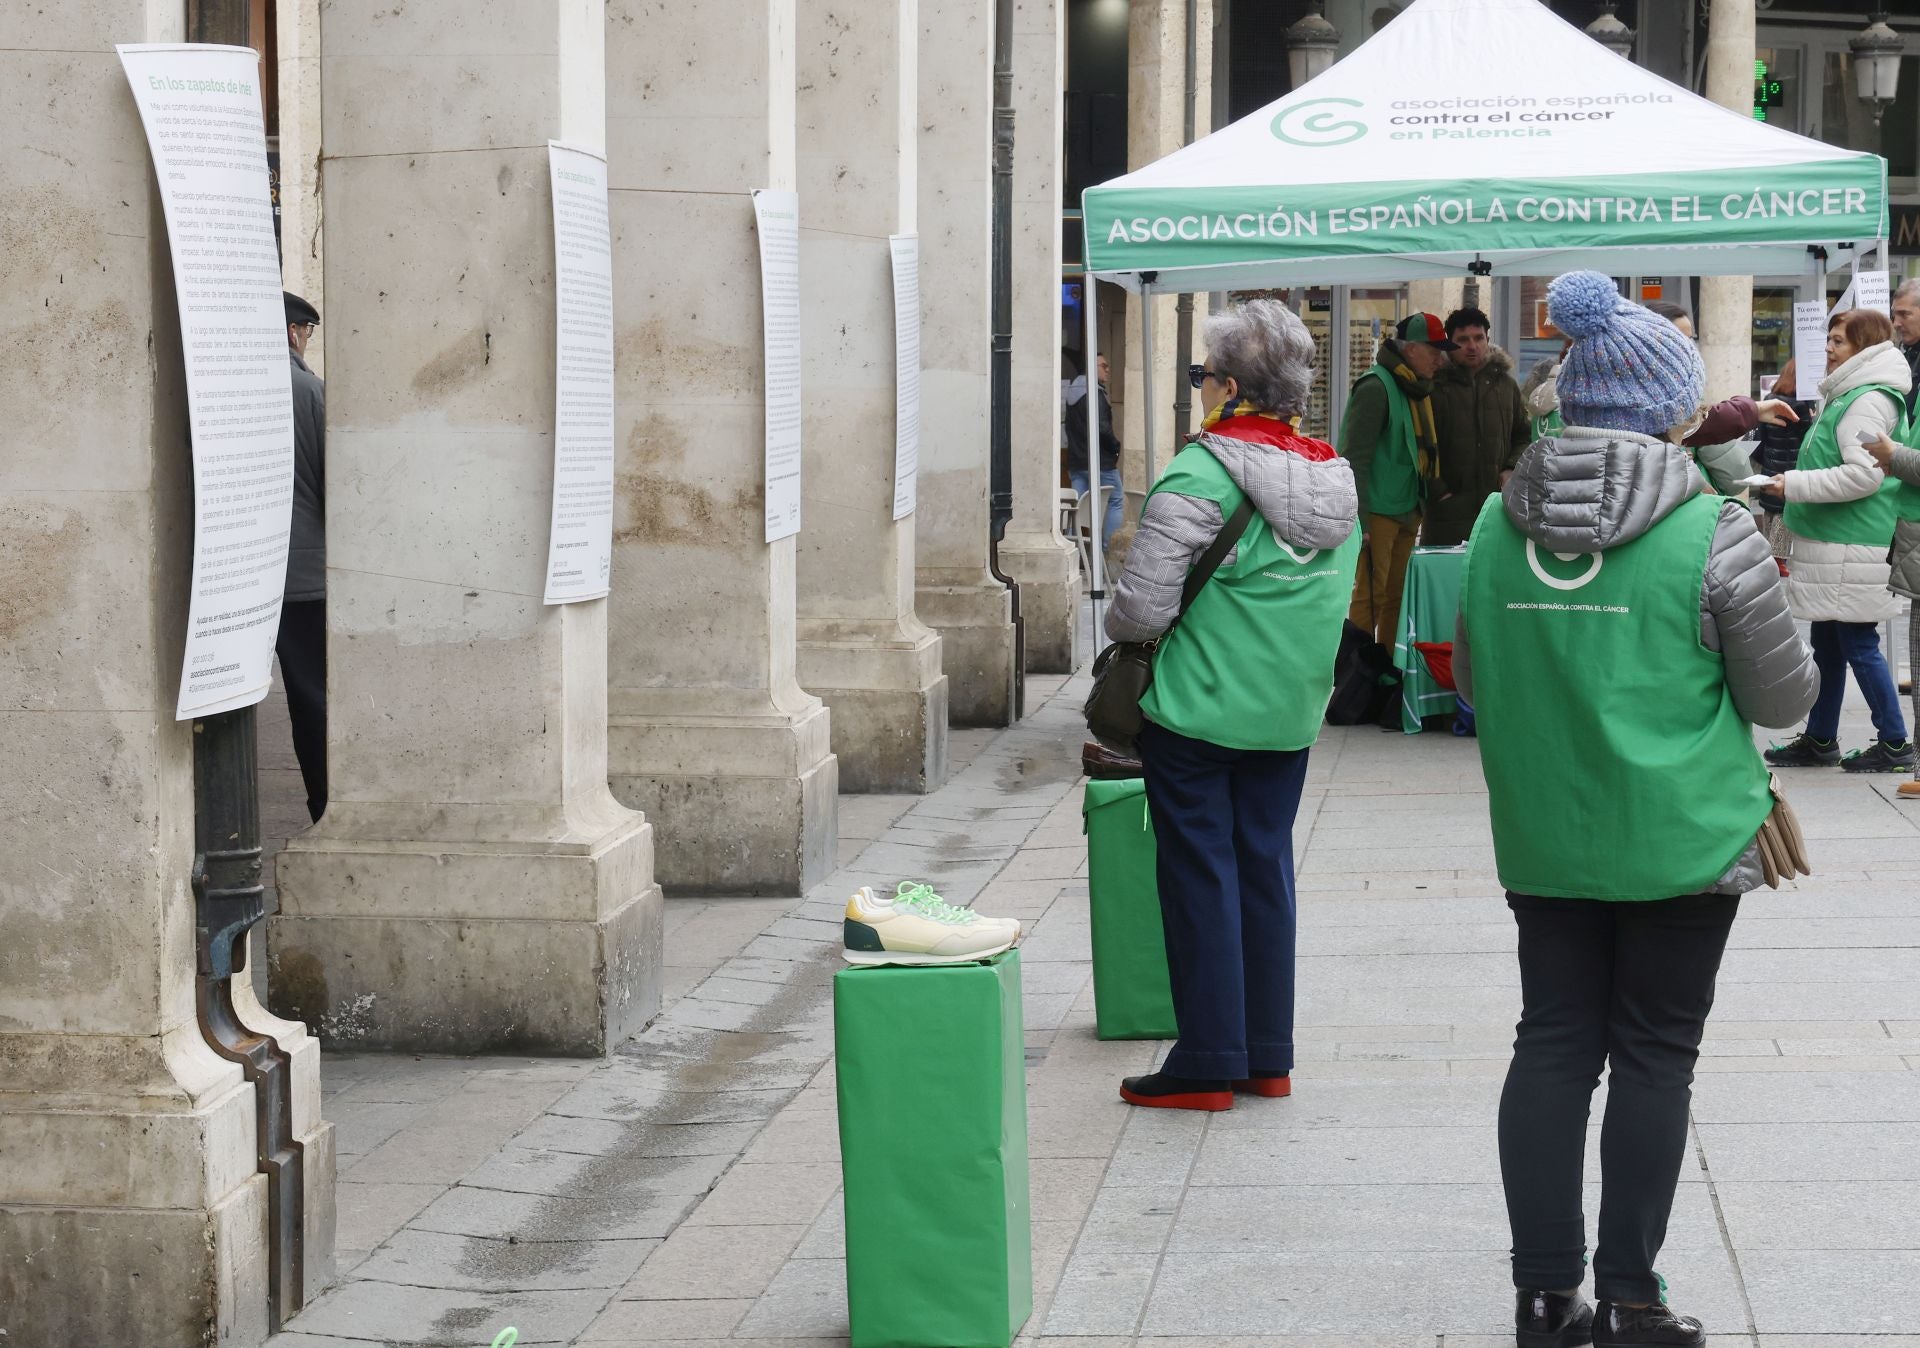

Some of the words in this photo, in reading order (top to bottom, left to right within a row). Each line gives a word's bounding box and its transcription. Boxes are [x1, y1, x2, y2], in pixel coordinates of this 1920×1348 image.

[148, 75, 166, 91] En
[166, 76, 185, 91] los
[188, 79, 226, 96] zapatos
[228, 80, 238, 94] de
[1391, 96, 1537, 110] asociación
[1546, 92, 1673, 109] española
[1390, 113, 1479, 125] contra
[1488, 112, 1510, 123] el
[1519, 110, 1615, 122] cáncer
[1390, 130, 1423, 141] en
[1432, 127, 1552, 140] Palencia
[1107, 206, 1318, 244] ASOCIACIÓN
[1329, 196, 1509, 234] ESPAÑOLA
[1517, 197, 1663, 223] CONTRA
[1671, 197, 1713, 222] EL
[1721, 187, 1866, 221] CÁNCER
[1263, 572, 1291, 581] ASOCIACIÓN
[1603, 605, 1629, 613] CÁNCER
